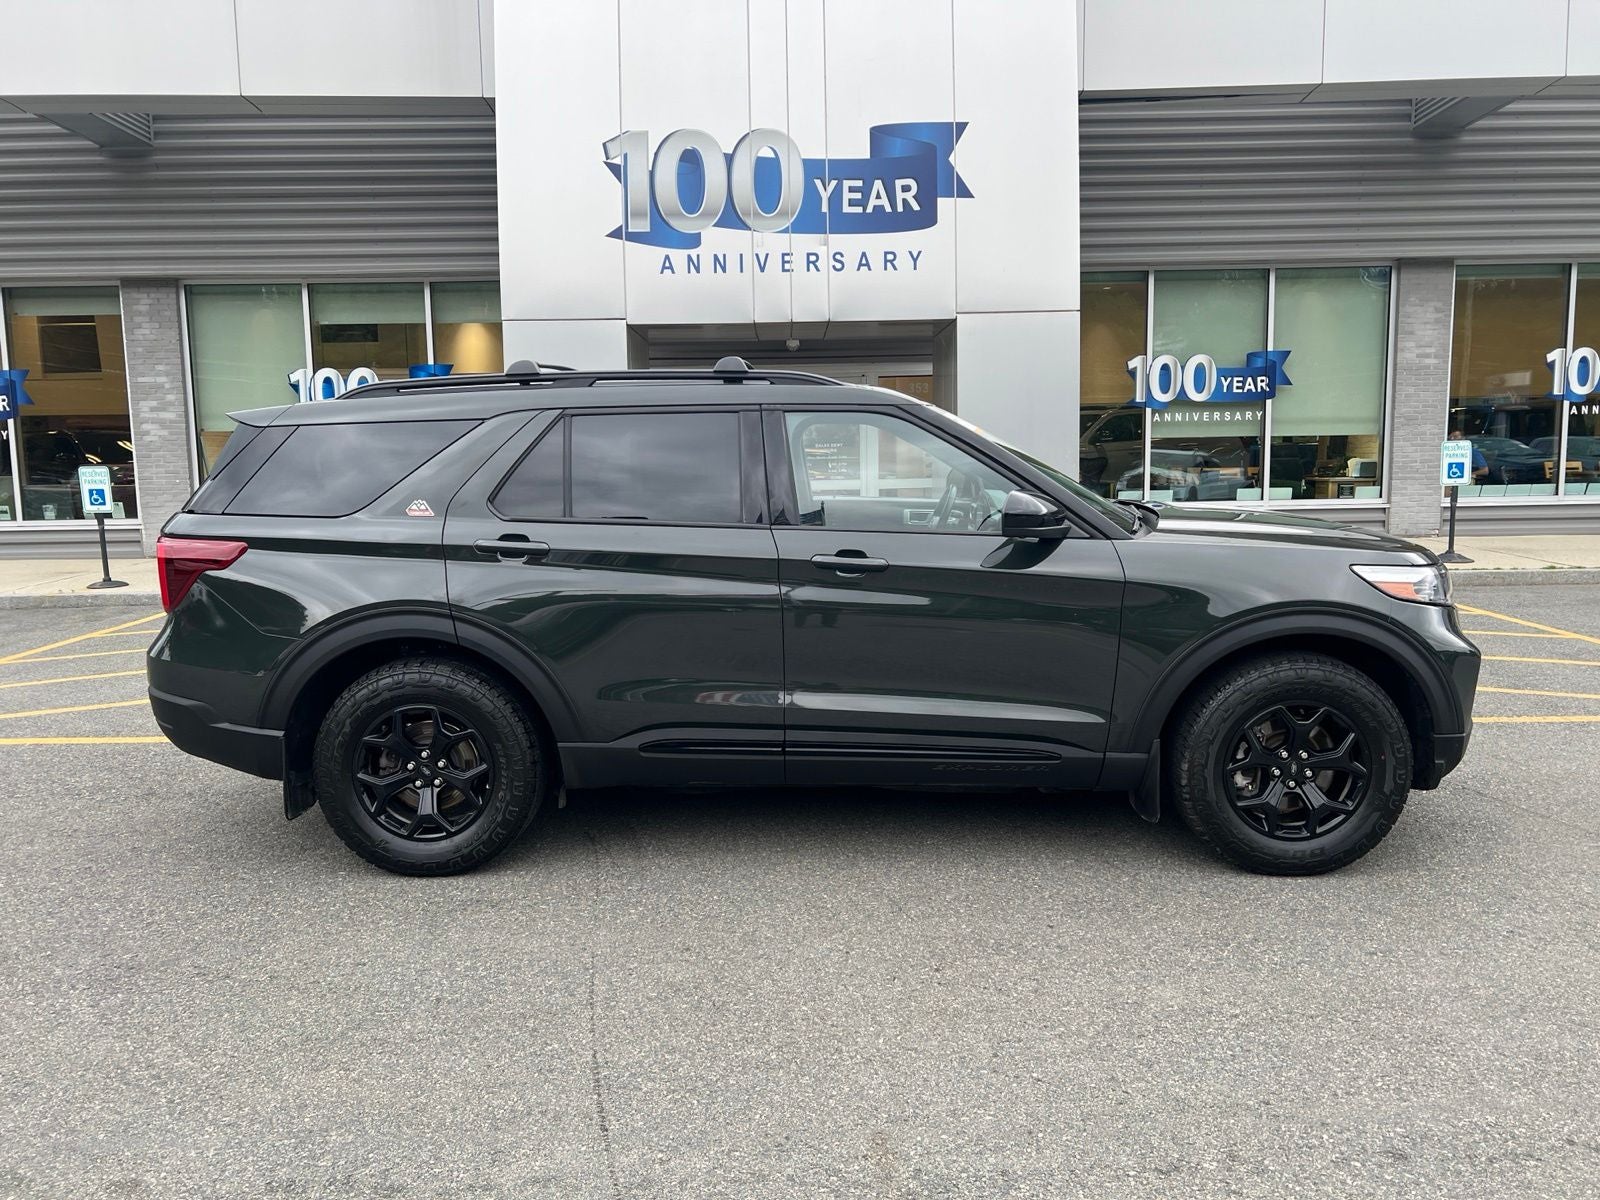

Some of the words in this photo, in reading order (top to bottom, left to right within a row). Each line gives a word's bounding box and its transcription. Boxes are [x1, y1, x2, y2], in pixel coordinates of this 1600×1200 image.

[602, 128, 804, 233] 100
[814, 178, 921, 214] YEAR
[660, 250, 923, 274] ANNIVERSARY
[1127, 354, 1217, 402] 100
[1220, 376, 1270, 393] YEAR
[1546, 347, 1600, 395] 10
[1153, 410, 1263, 422] ANNIVERSARY
